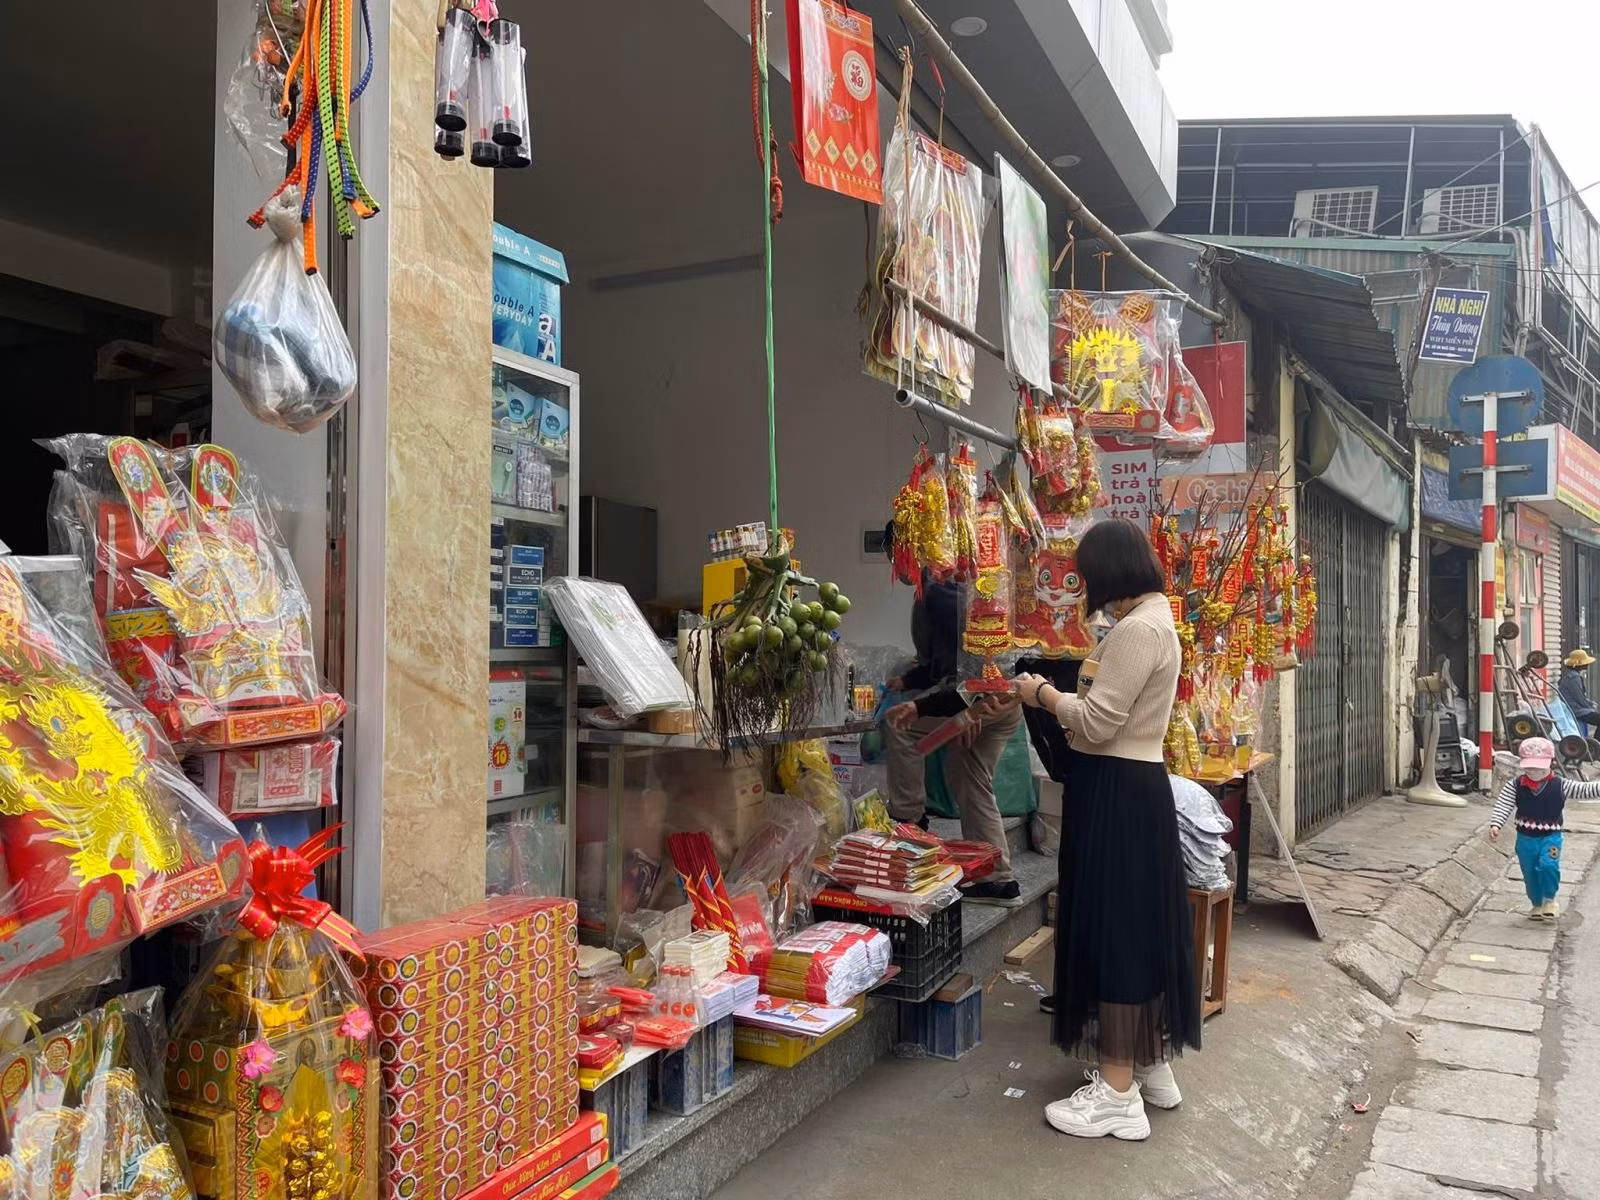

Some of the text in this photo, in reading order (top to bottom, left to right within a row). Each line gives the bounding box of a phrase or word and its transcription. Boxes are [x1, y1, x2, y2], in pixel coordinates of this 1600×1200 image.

[492, 234, 531, 257] ouble A
[494, 293, 524, 313] ouble
[527, 305, 534, 317] A
[1110, 462, 1147, 475] SIM
[1110, 476, 1140, 490] trả
[1110, 491, 1147, 505] hoà
